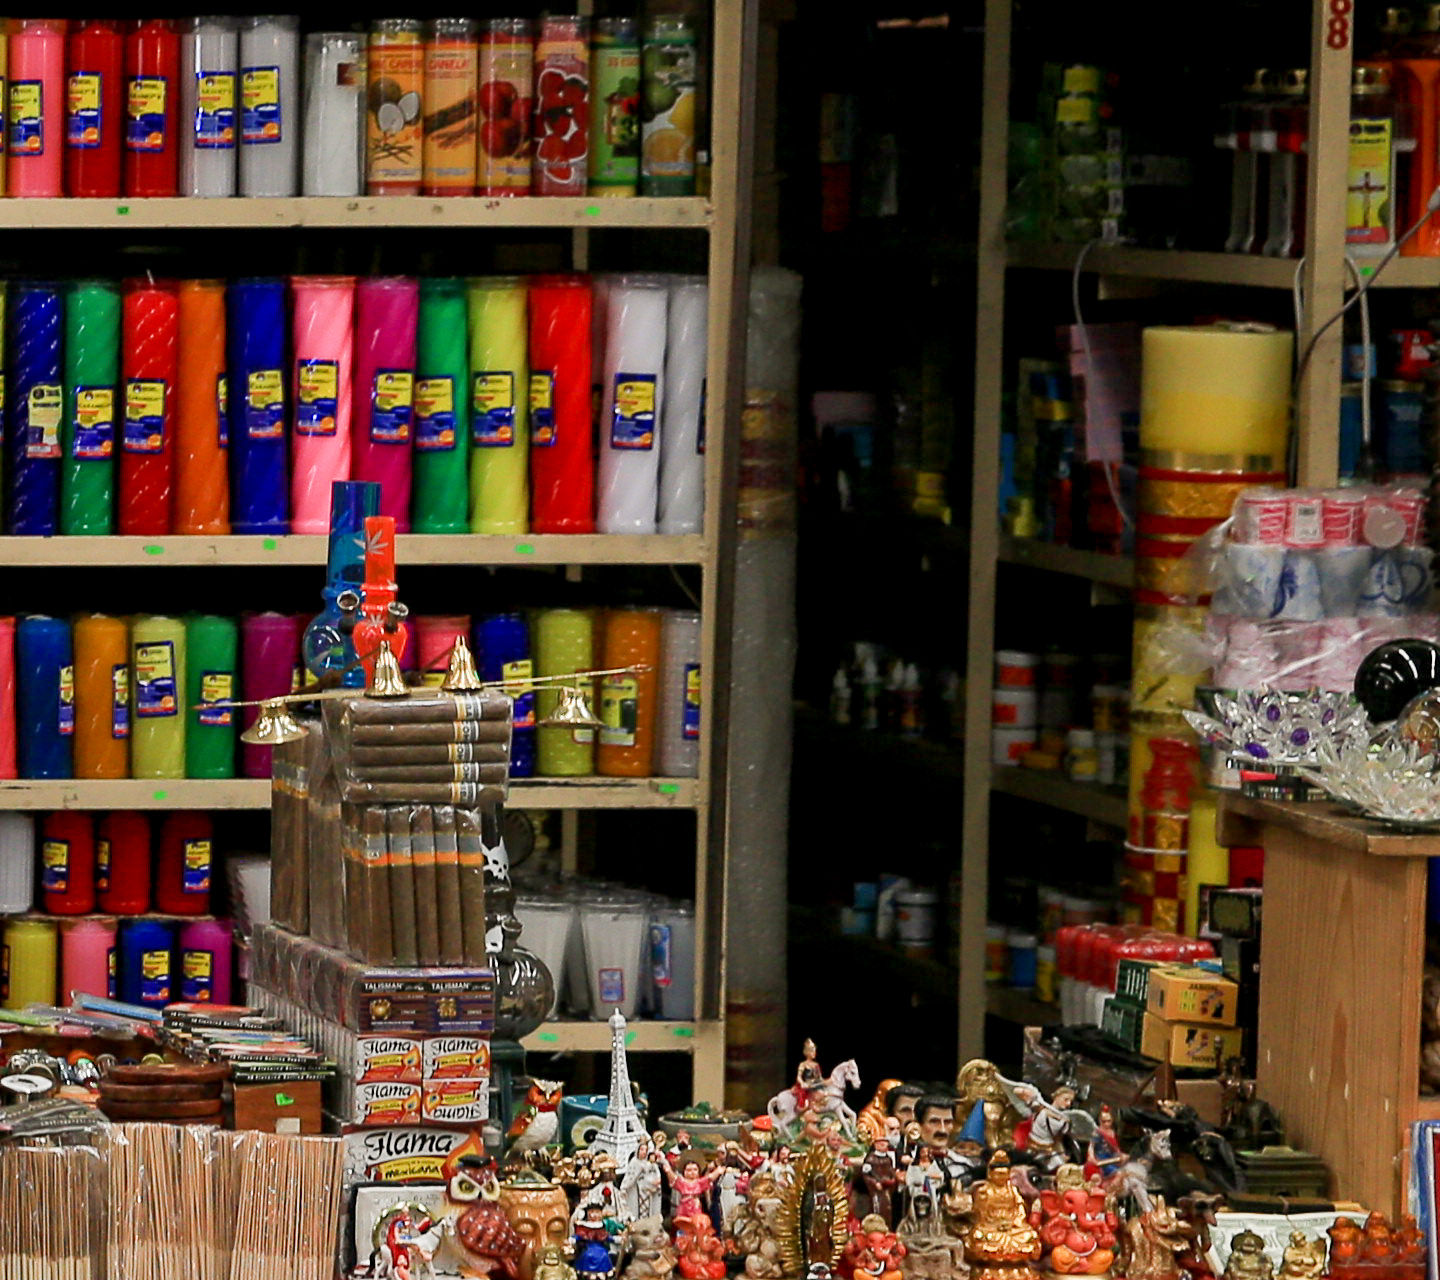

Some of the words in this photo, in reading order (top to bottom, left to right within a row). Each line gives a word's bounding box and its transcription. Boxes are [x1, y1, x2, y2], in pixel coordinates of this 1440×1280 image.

[364, 982, 404, 991] TALISMAN
[431, 982, 470, 991] TALISMAN
[363, 1038, 413, 1057] Flama
[431, 1038, 480, 1057] Flama
[363, 1083, 413, 1102] Flama
[432, 1103, 481, 1120] Flama
[364, 1130, 455, 1162] Flama
